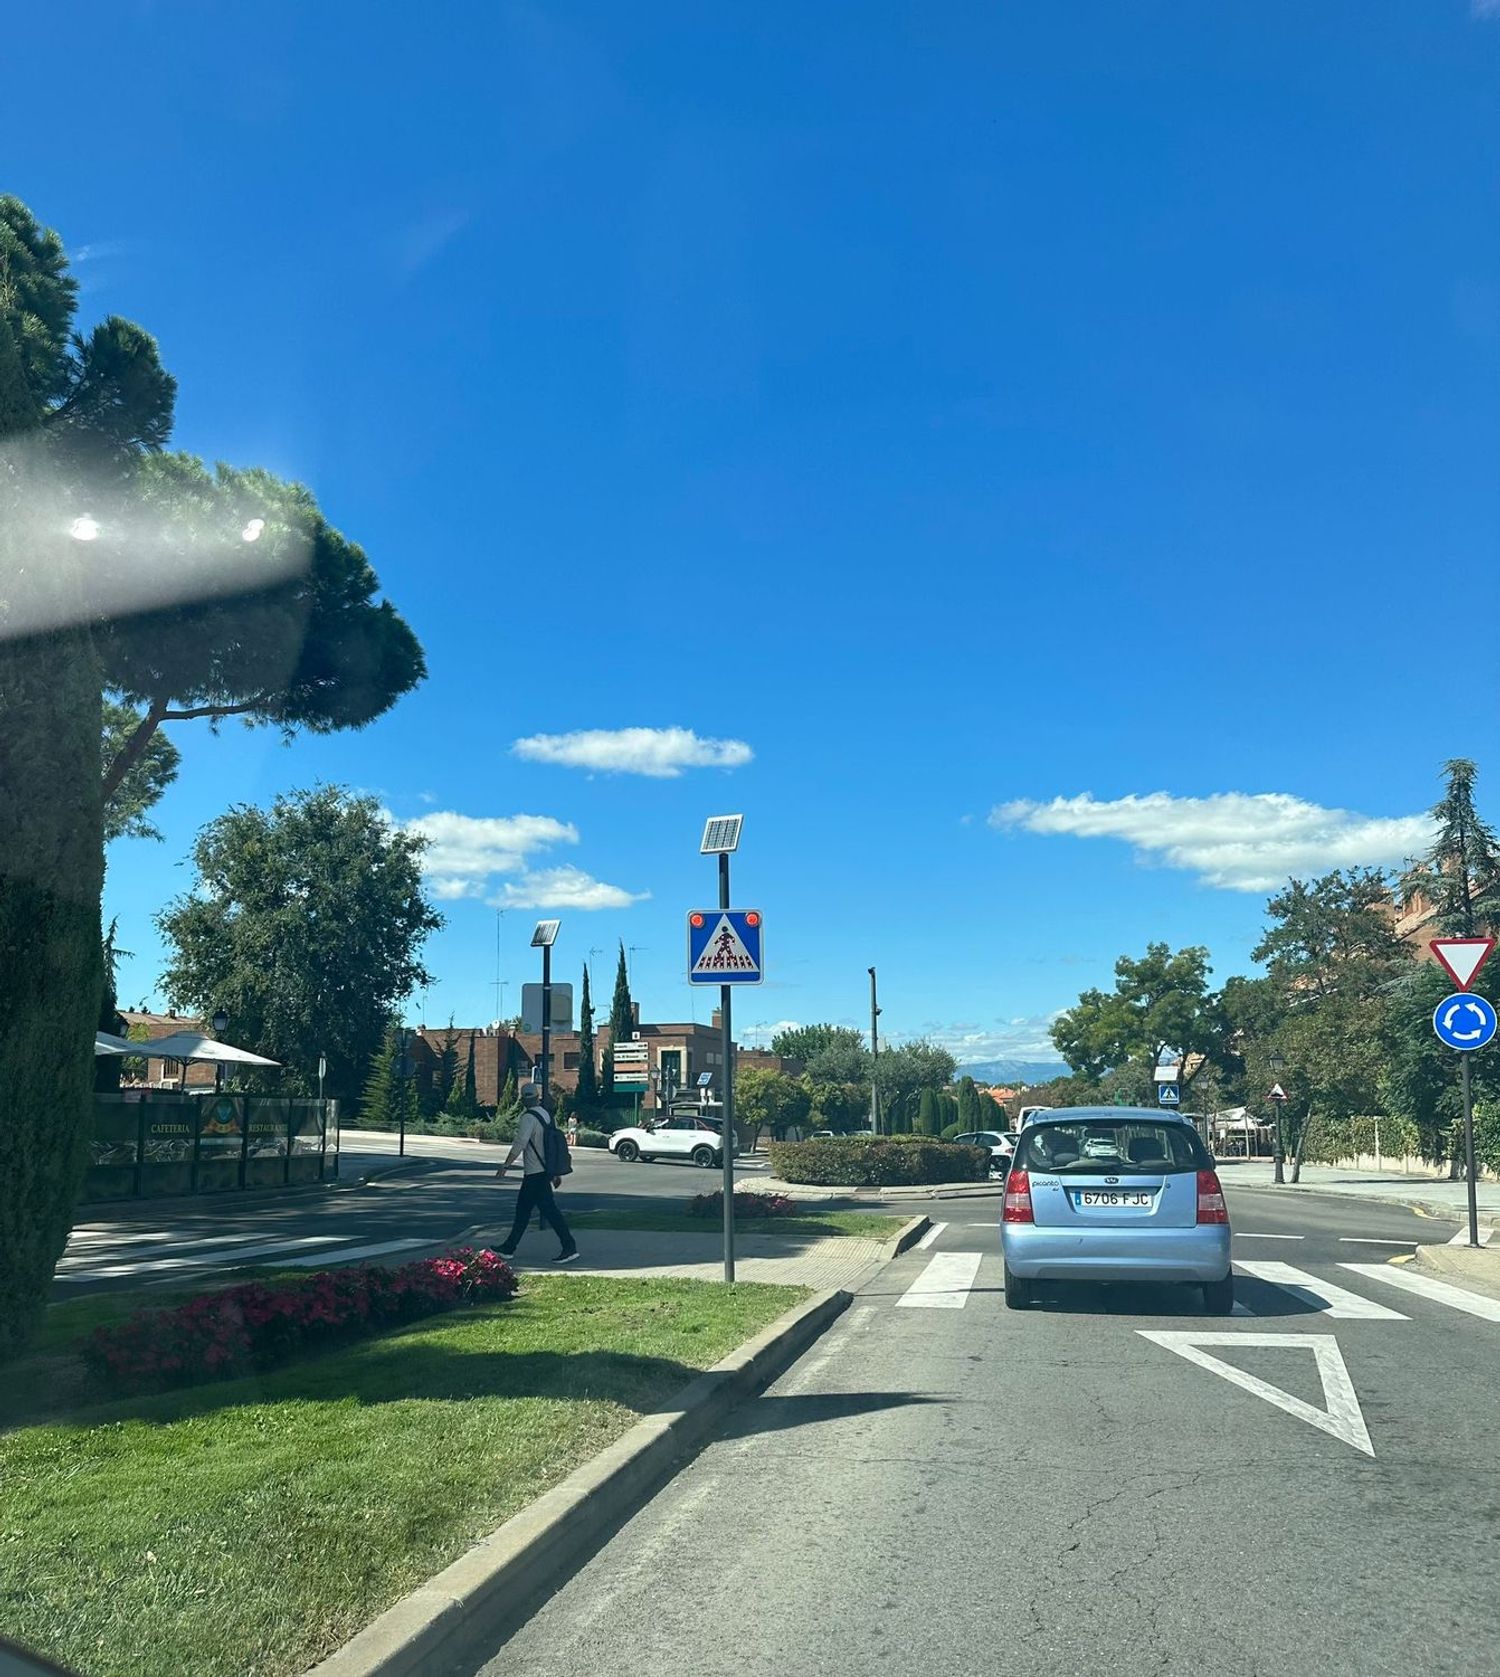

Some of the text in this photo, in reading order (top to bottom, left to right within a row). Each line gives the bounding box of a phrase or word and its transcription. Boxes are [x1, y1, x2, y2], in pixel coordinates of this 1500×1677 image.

[150, 1123, 190, 1134] CAFETERIA
[1031, 1180, 1060, 1188] picanto
[1084, 1192, 1149, 1205] 6706 FJC
